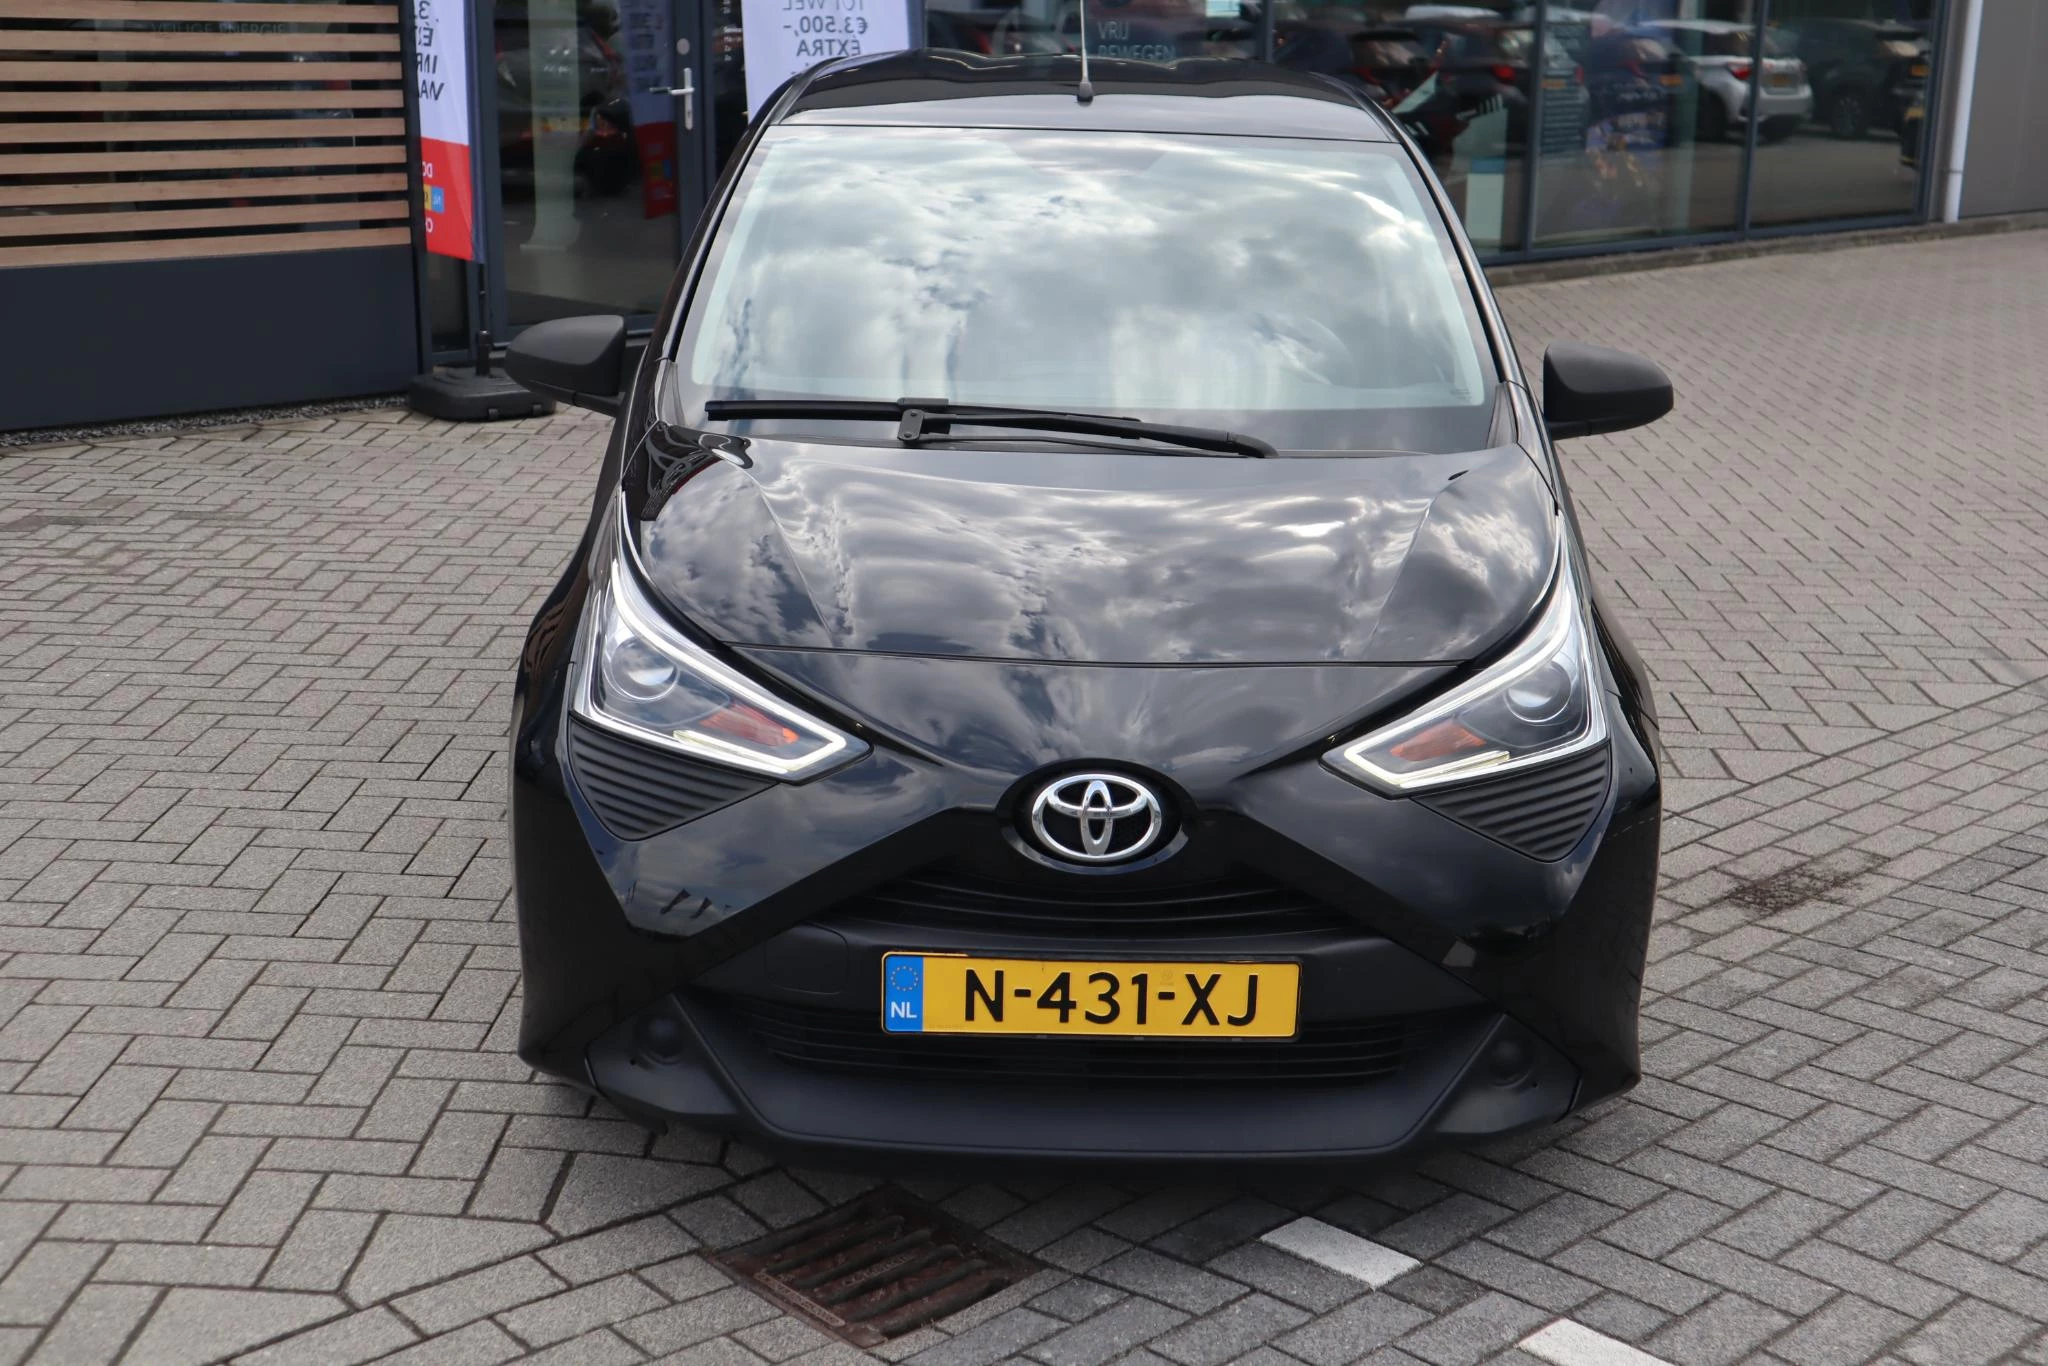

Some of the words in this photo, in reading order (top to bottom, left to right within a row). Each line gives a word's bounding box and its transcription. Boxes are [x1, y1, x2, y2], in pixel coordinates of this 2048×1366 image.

[1097, 20, 1129, 40] VRIJ
[891, 1001, 917, 1019] NL
[965, 969, 1258, 1028] N-431-XJ
